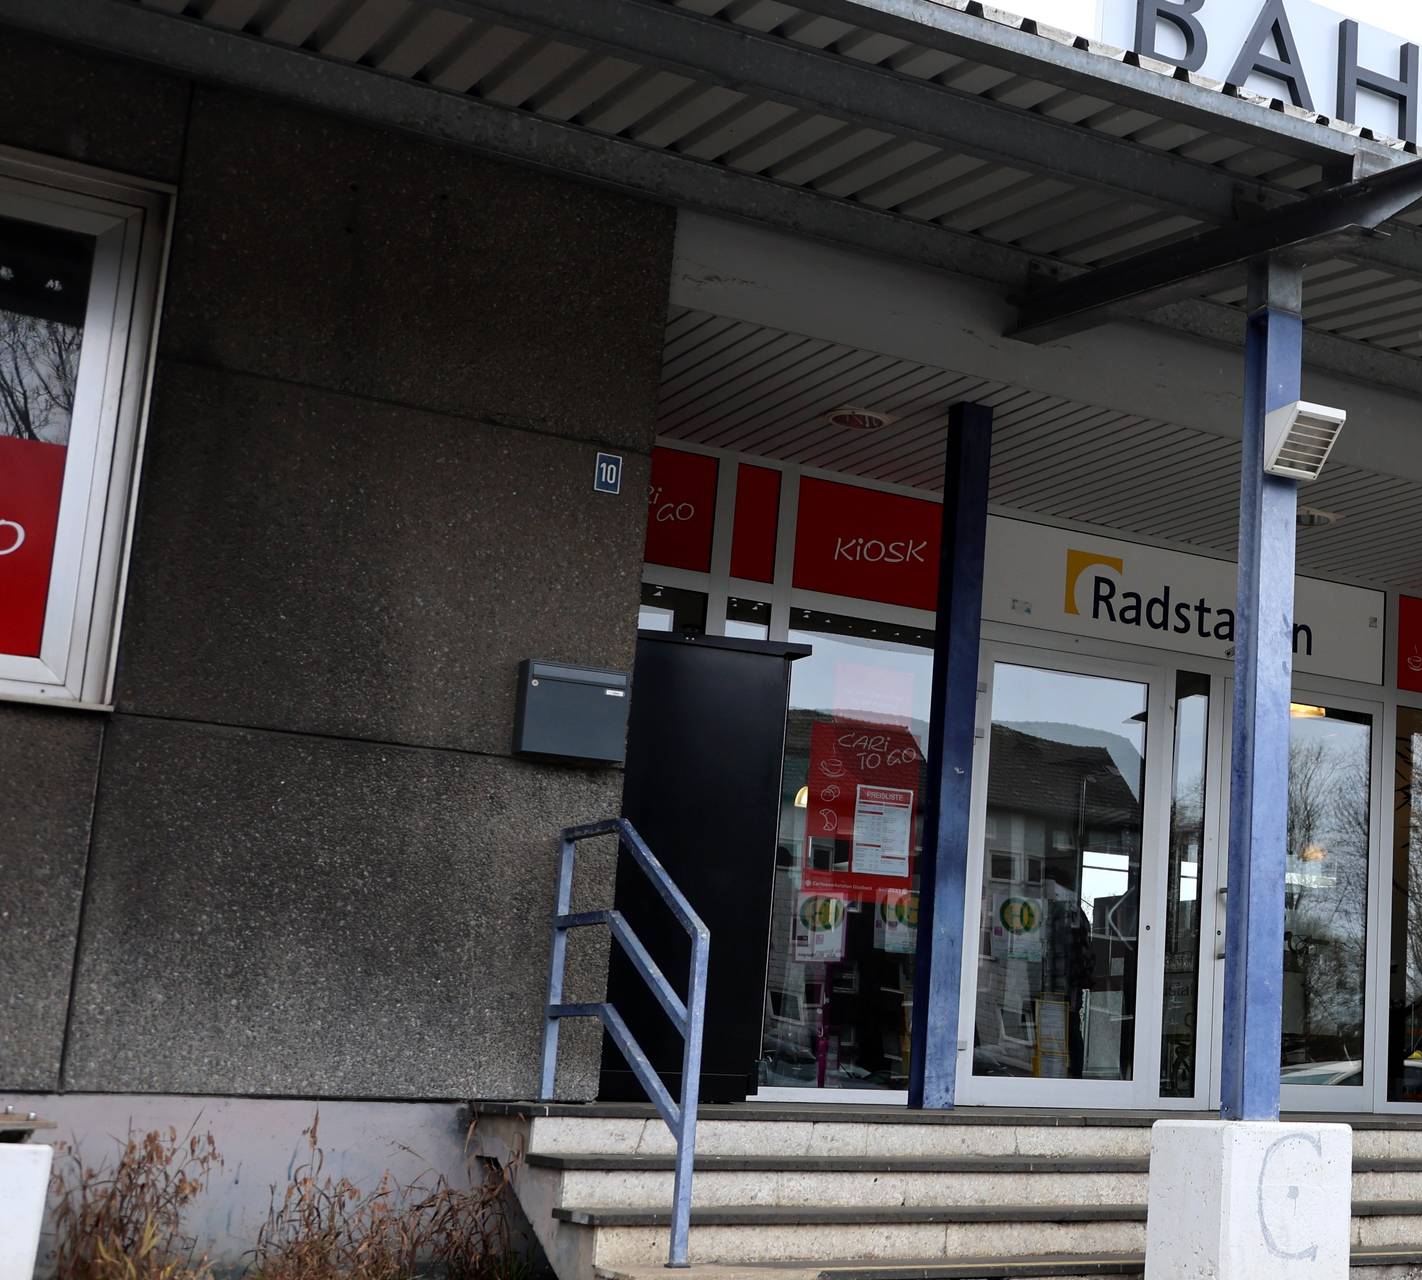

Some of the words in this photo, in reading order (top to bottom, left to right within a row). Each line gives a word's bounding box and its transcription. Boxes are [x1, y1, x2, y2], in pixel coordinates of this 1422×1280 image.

[600, 462, 617, 484] 10
[1091, 575, 1313, 655] Radstan
[856, 752, 881, 770] TO
[887, 747, 917, 766] GO
